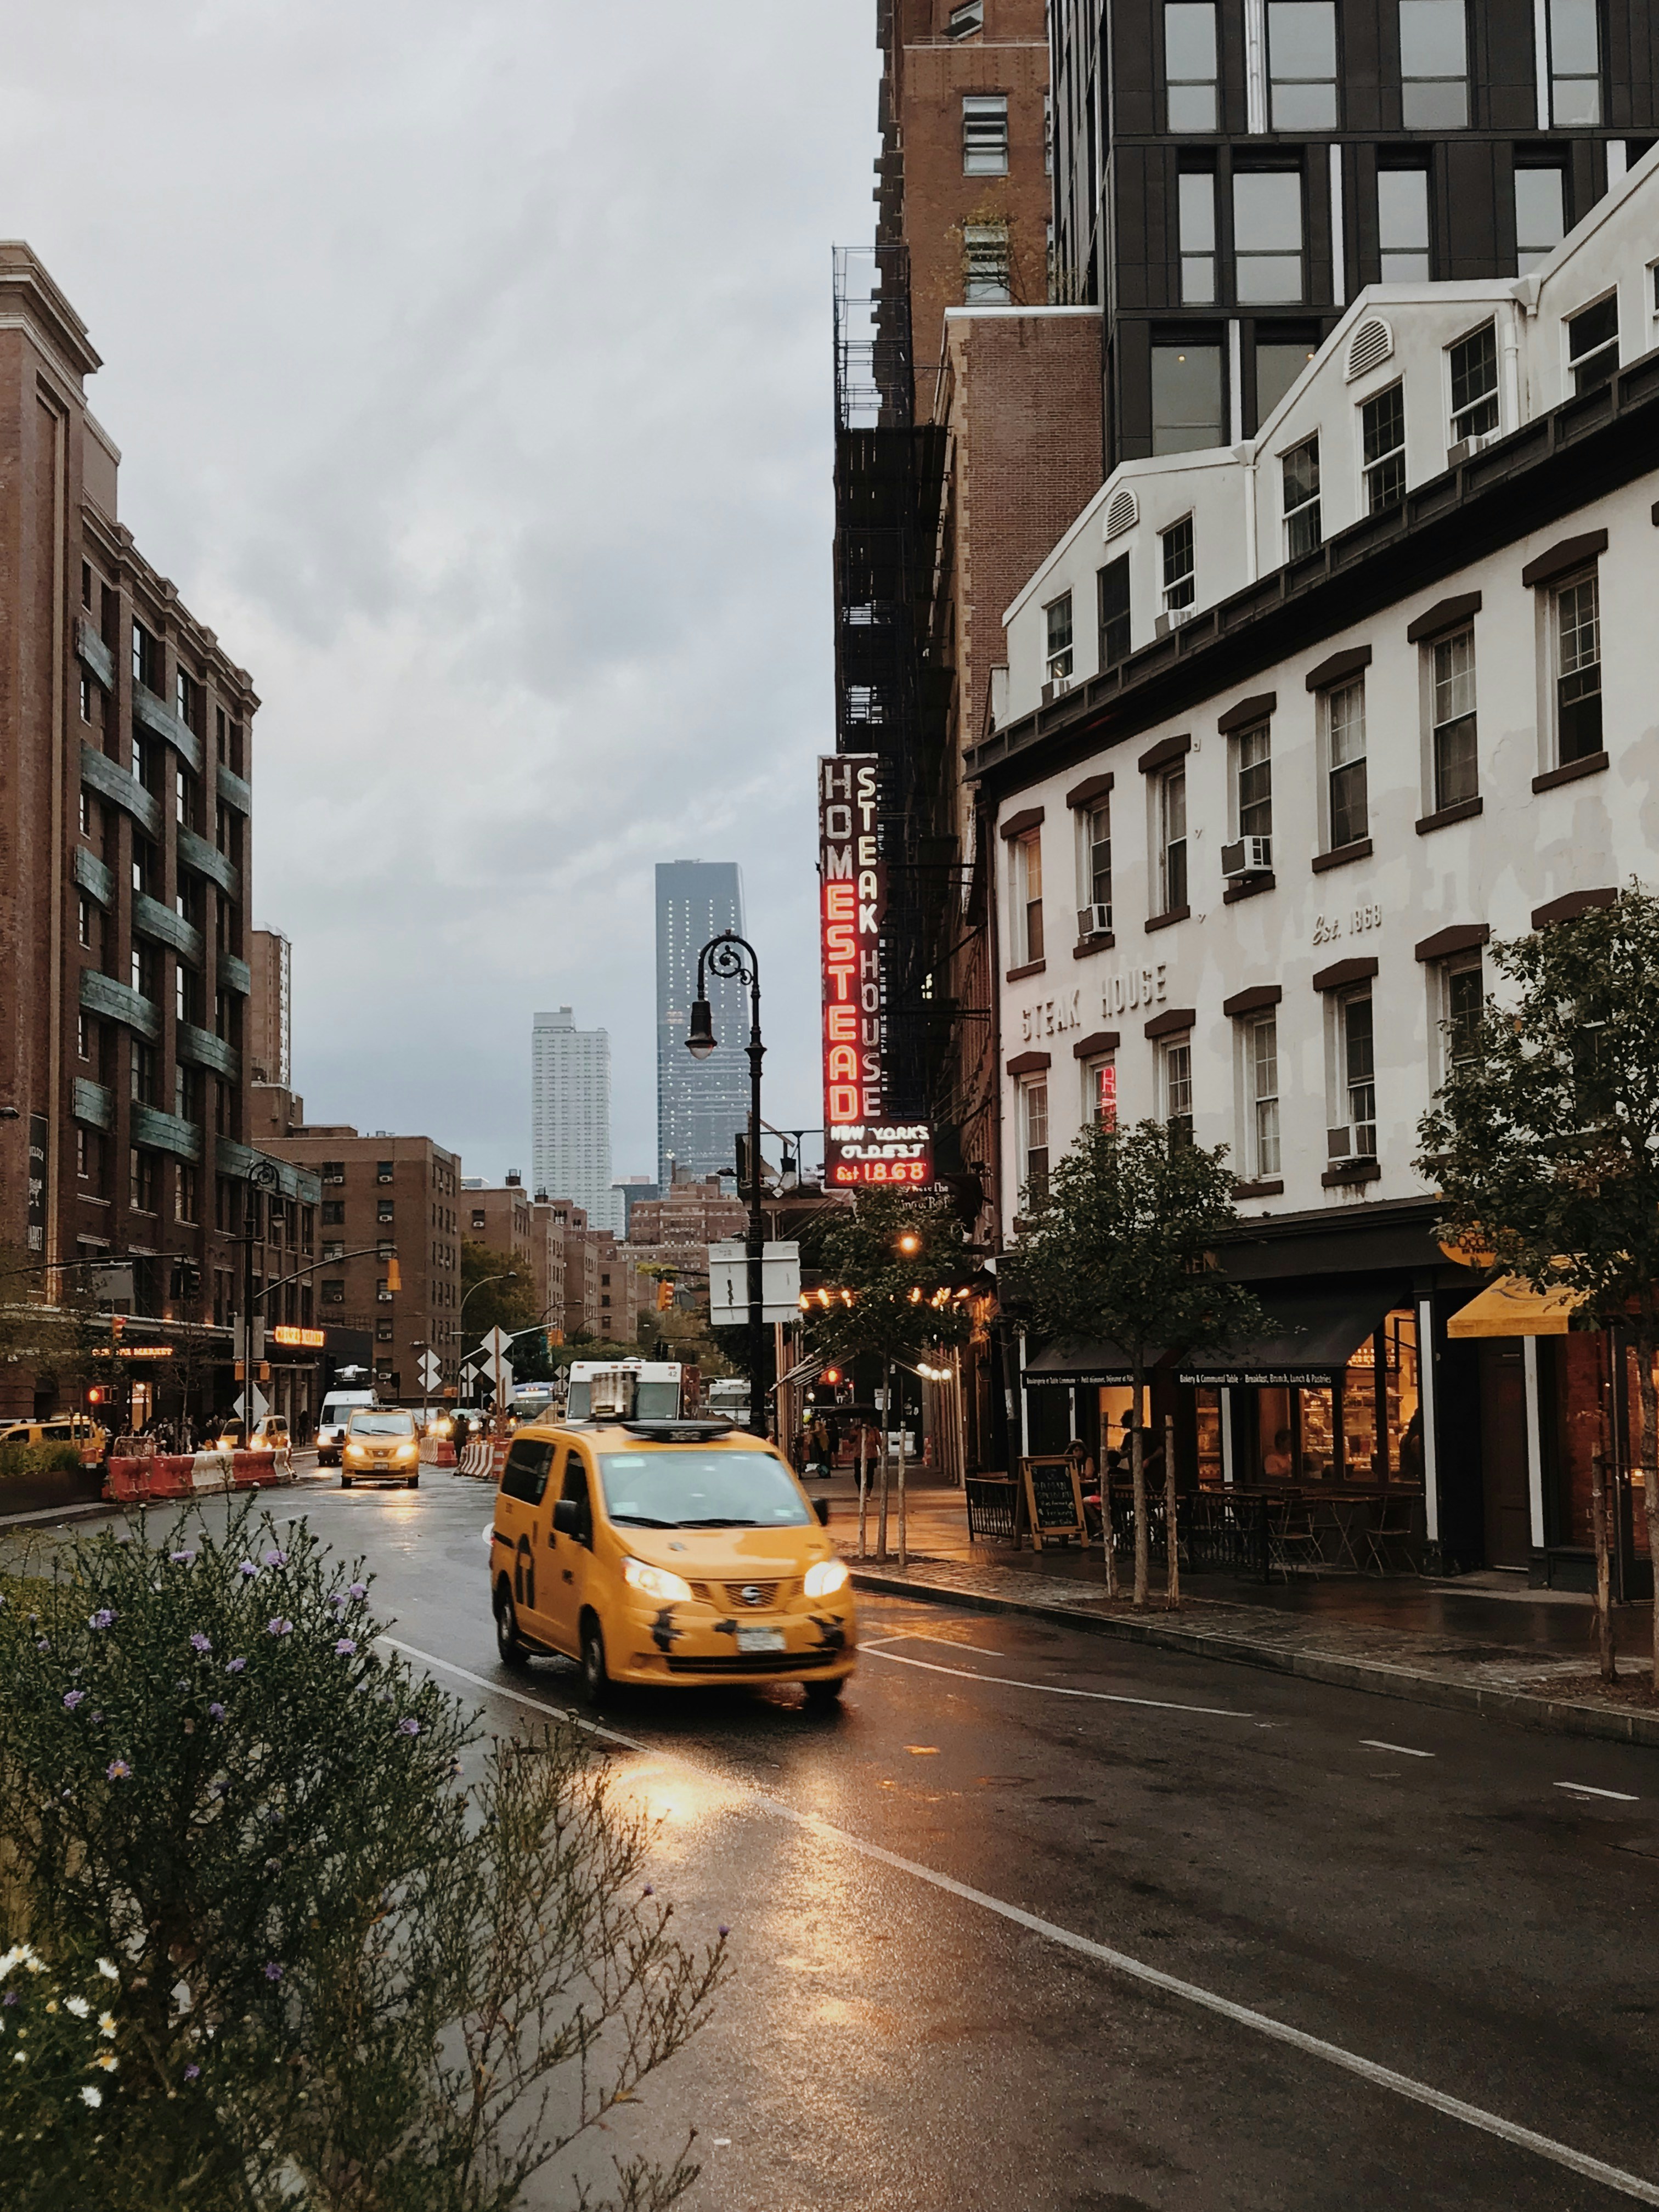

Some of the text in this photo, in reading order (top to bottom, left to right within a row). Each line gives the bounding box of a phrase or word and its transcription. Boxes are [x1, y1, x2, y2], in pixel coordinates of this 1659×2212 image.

[1312, 902, 1382, 946] Est. 1868
[824, 764, 858, 1121] HOMESTEAD
[856, 766, 882, 1117] STEAK HOUSE
[1022, 962, 1167, 1042] STEAK HOUSE
[830, 1125, 930, 1141] NEW YORK'S
[840, 1143, 925, 1159] OLDEST
[864, 1161, 927, 1181] 1868
[133, 1347, 173, 1356] MARKET
